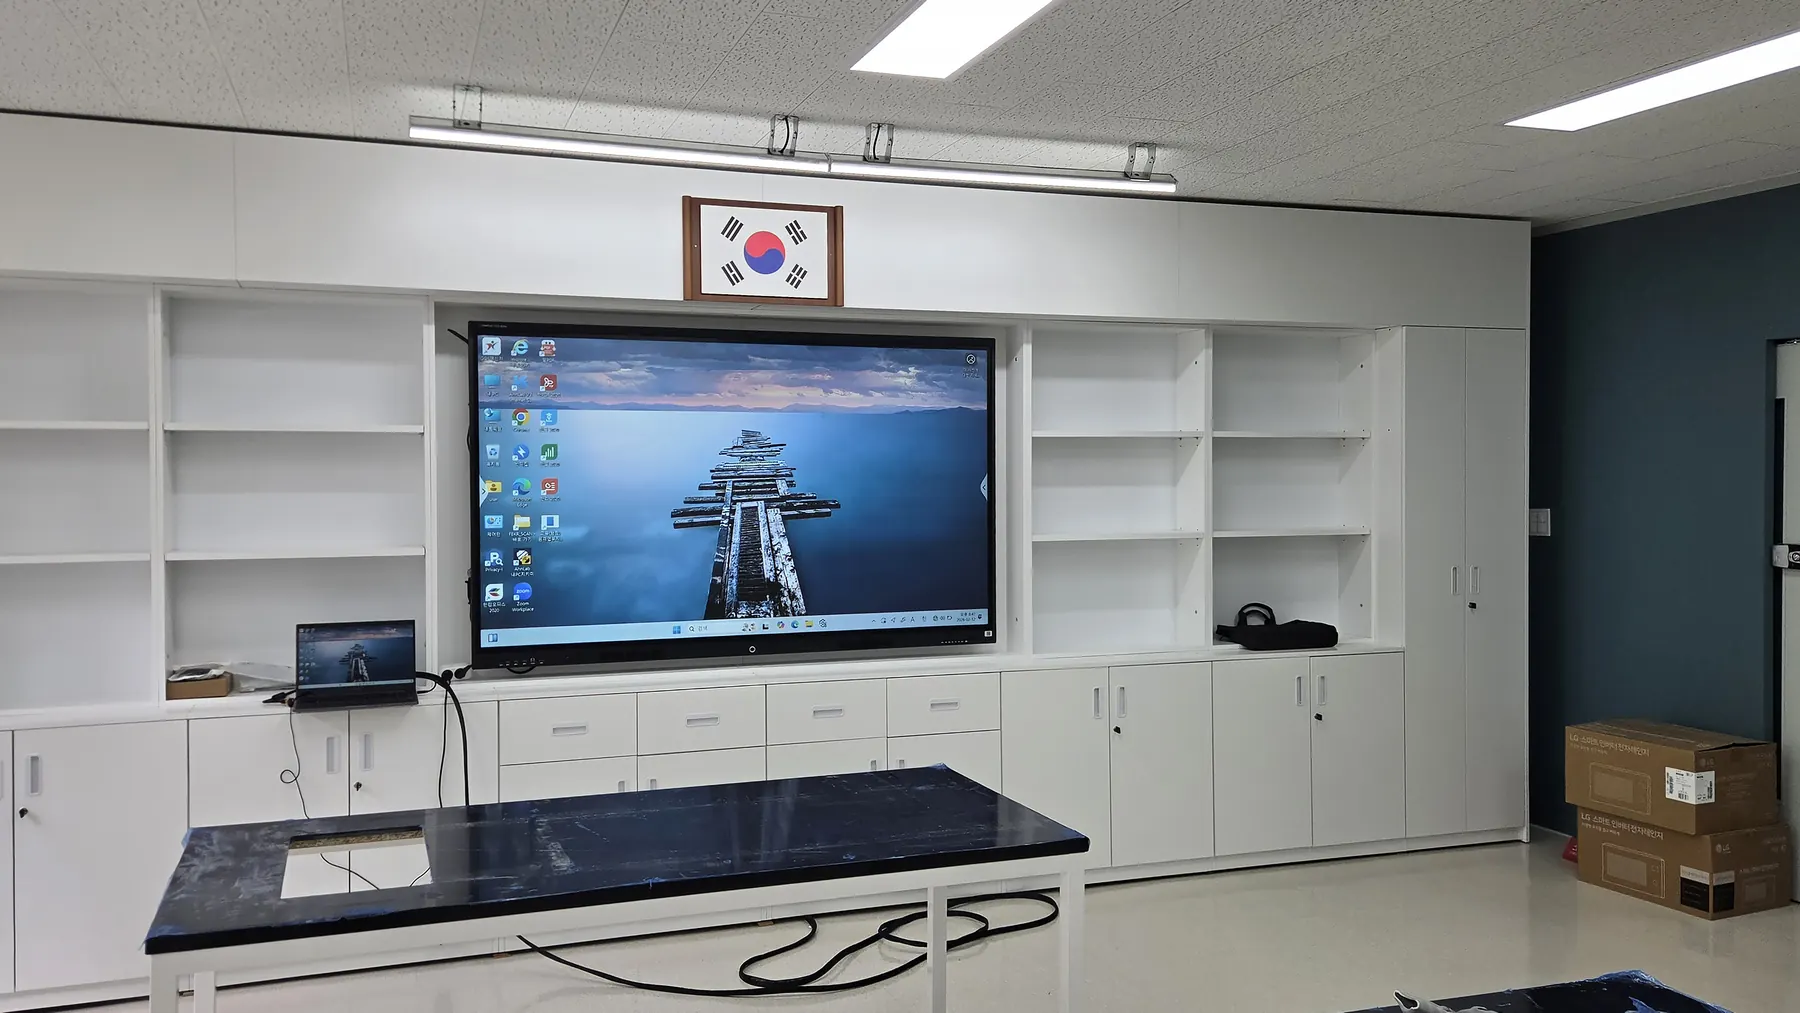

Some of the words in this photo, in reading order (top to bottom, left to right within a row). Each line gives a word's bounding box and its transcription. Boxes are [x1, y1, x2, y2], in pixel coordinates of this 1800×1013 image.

[1569, 733, 1579, 742] LG
[1580, 735, 1599, 746] 스마트
[1581, 812, 1591, 821] LG
[1592, 815, 1611, 826] 스마트
